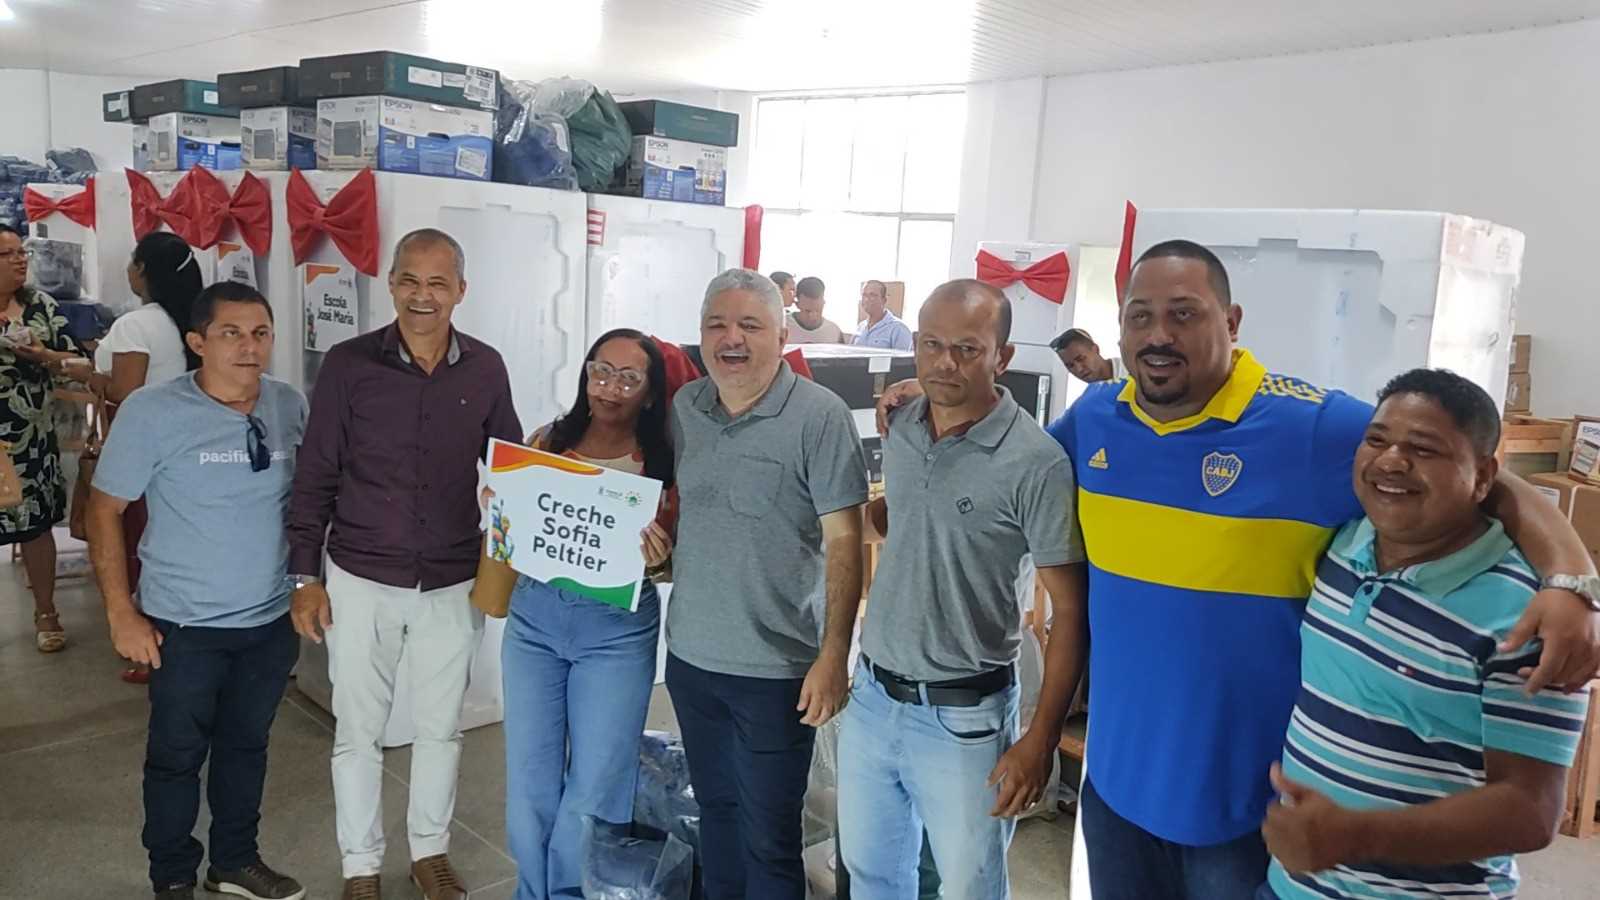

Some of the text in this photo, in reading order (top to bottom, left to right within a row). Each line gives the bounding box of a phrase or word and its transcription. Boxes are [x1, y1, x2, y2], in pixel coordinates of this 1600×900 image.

[317, 307, 354, 325] José Maria
[324, 293, 347, 308] Escola
[537, 492, 616, 529] Creche
[542, 516, 601, 549] Sofia
[533, 535, 607, 572] Peltier
